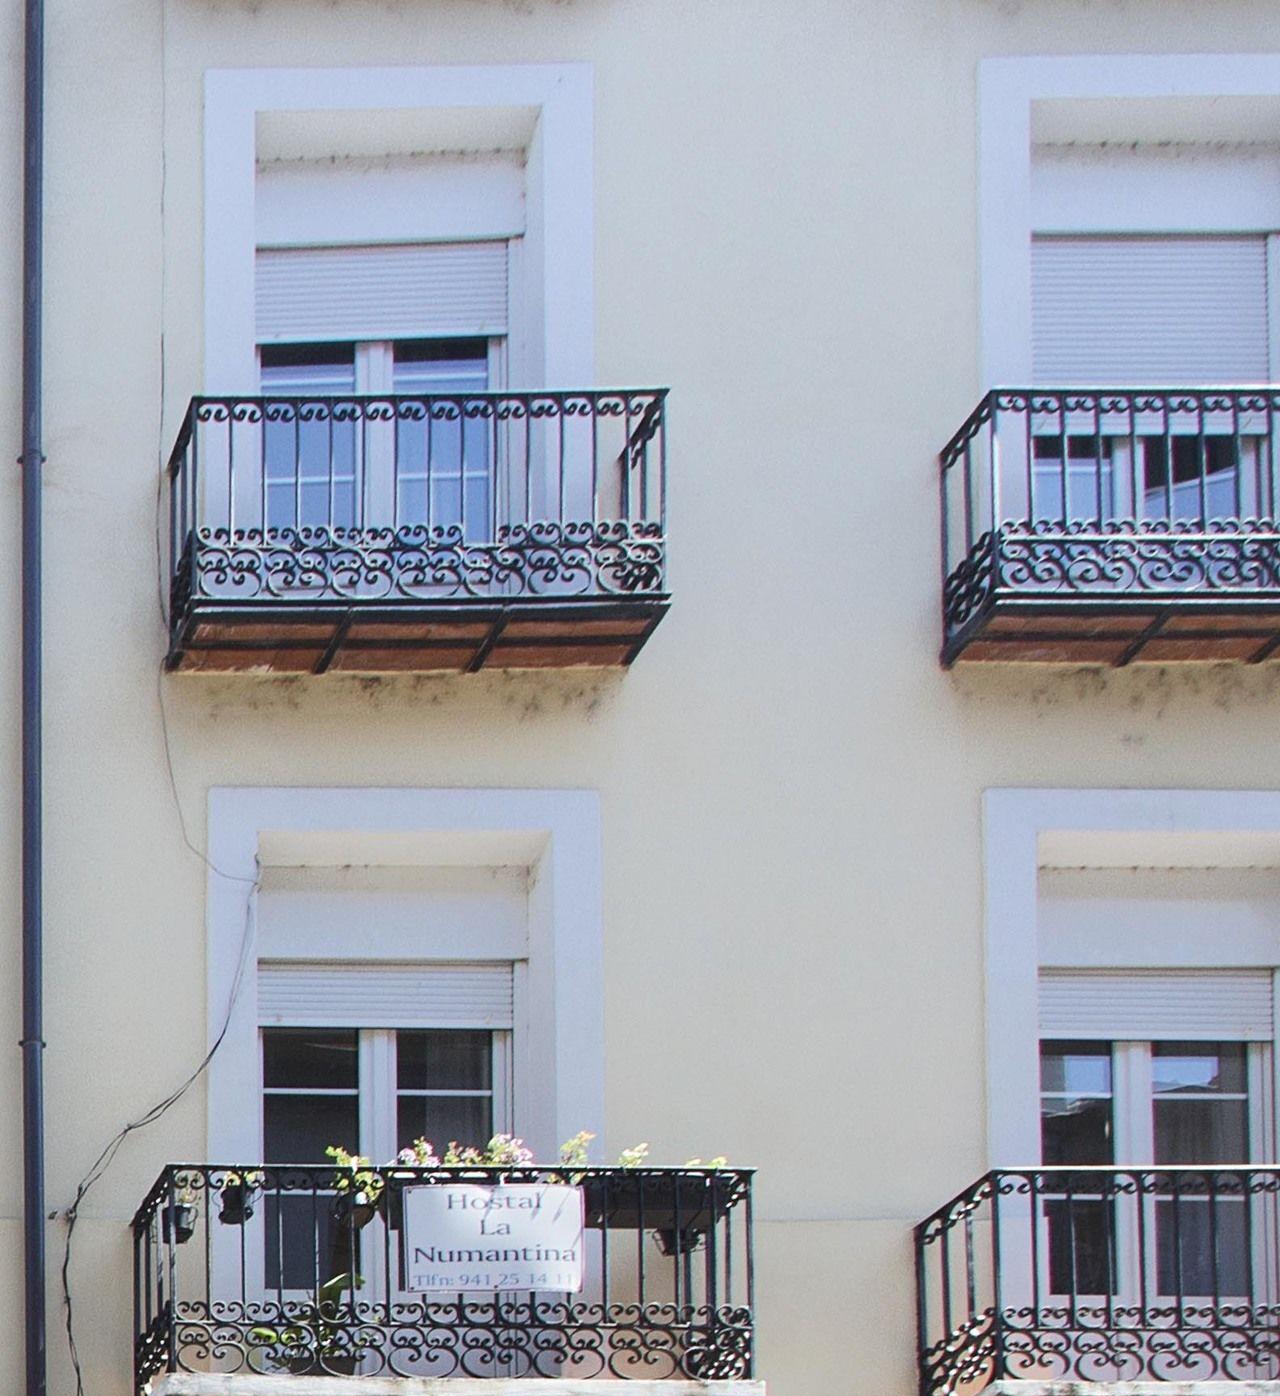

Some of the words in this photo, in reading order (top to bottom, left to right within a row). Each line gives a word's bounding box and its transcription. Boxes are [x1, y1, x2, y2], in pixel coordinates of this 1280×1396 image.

[447, 1193, 543, 1210] Hostal
[480, 1219, 511, 1236] La
[414, 1245, 576, 1264] Numantina
[459, 1274, 491, 1286] 941
[499, 1273, 520, 1286] 25
[531, 1273, 547, 1285] 14
